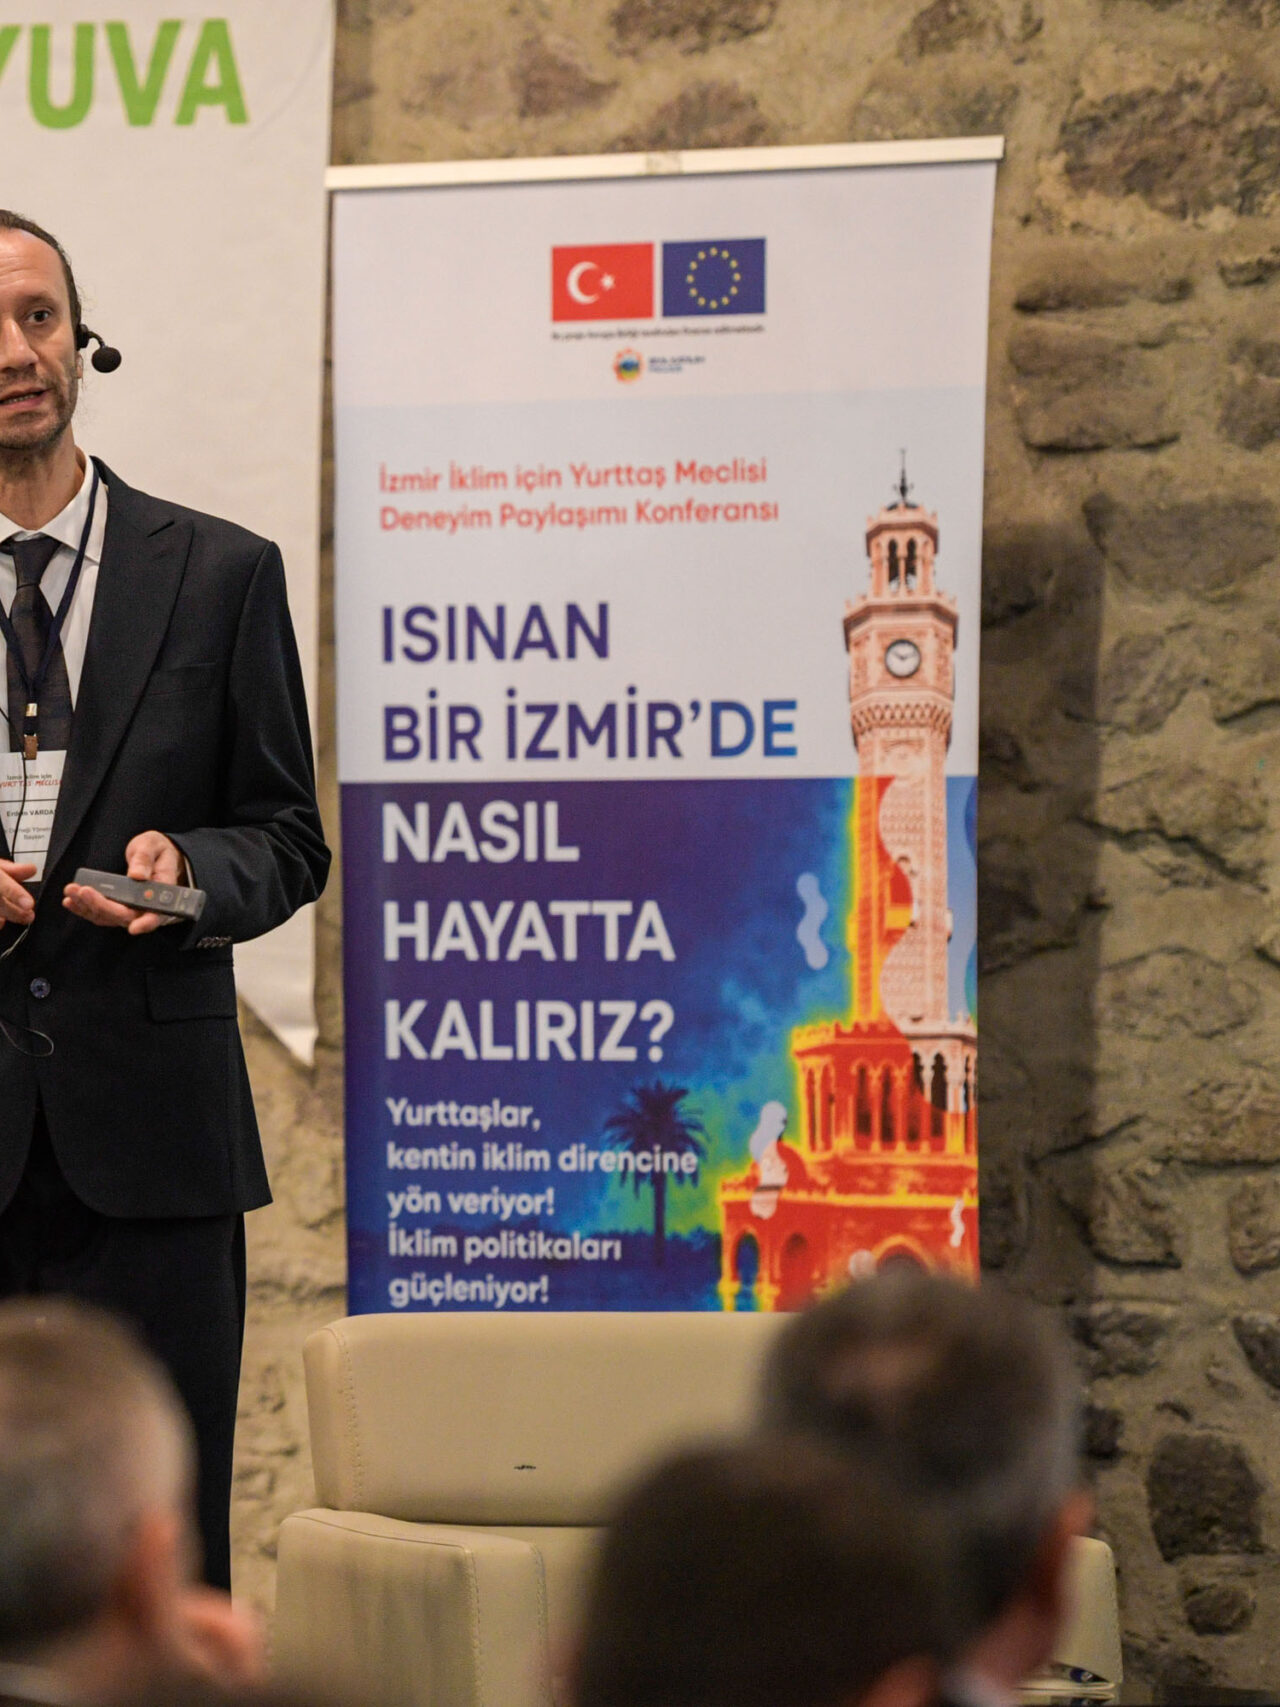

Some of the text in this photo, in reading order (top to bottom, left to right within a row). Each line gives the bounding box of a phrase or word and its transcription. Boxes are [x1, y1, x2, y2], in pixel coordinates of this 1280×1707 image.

[380, 459, 766, 493] İzmir İklim için Yurttaş Meclisi
[380, 498, 779, 534] Deneyim Paylaşımı Konferansı
[383, 603, 609, 663] ISINAN
[384, 686, 797, 762] BİR İZMİR’DE
[30, 808, 55, 816] VARDA
[382, 800, 579, 863] NASIL
[384, 900, 676, 961] HAYATTA
[385, 999, 674, 1062] KALIRIZ?
[386, 1097, 540, 1132] Yurttaşlar,
[387, 1142, 699, 1174] kentin iklim direncine
[387, 1185, 555, 1221] yön veriyor!
[389, 1221, 622, 1264] İklim politikaları
[388, 1273, 550, 1309] güçleniyor!
